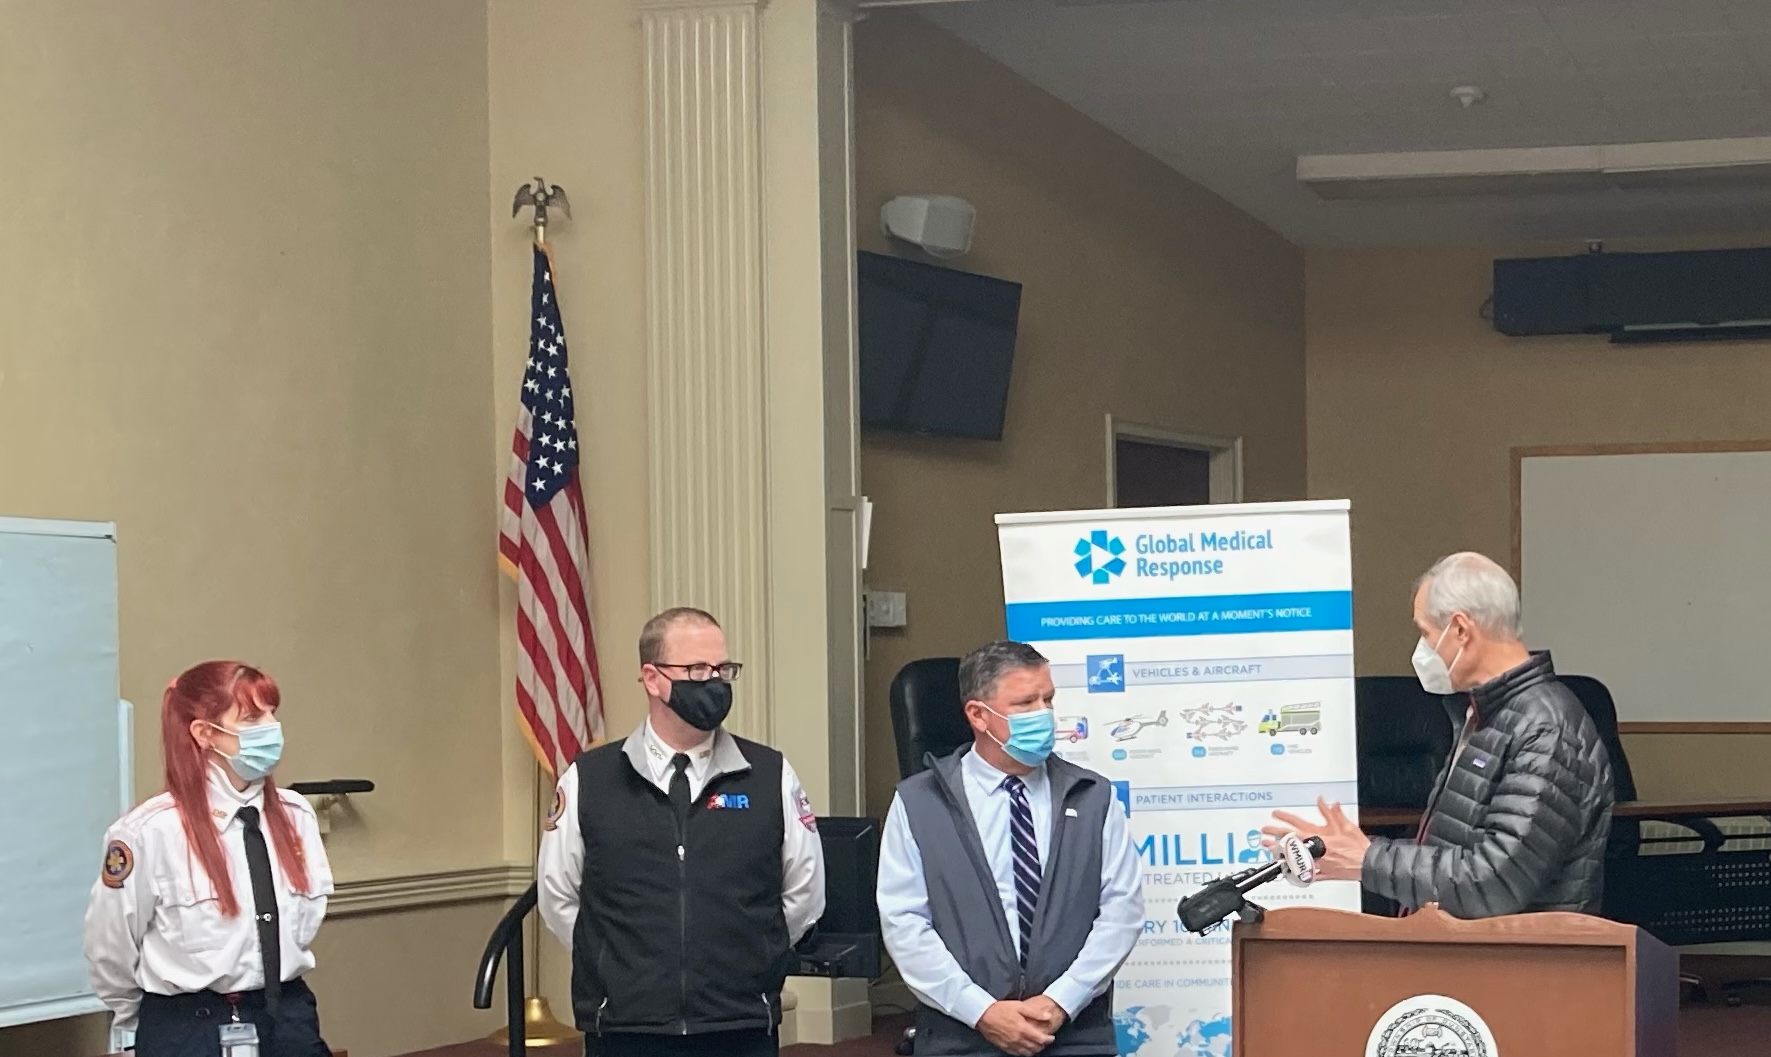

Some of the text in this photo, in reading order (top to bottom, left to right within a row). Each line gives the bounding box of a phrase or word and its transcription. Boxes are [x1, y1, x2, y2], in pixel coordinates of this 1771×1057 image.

[1135, 529, 1273, 555] Global Medical
[1136, 556, 1224, 581] Response
[1040, 607, 1312, 627] PROVIDING CARE TO THE WORLD AT A MOMENT'S NOTICE
[1132, 664, 1262, 678] VEHICLES & AIRCRAFT
[1136, 791, 1273, 805] PATIENT INTERACTIONS
[1289, 840, 1308, 874] WMUR
[1144, 872, 1213, 885] TREATED
[1144, 920, 1167, 934] RY
[1195, 937, 1232, 945] CRITICA
[1115, 978, 1232, 989] IDE CARE IN COMMUNIT
